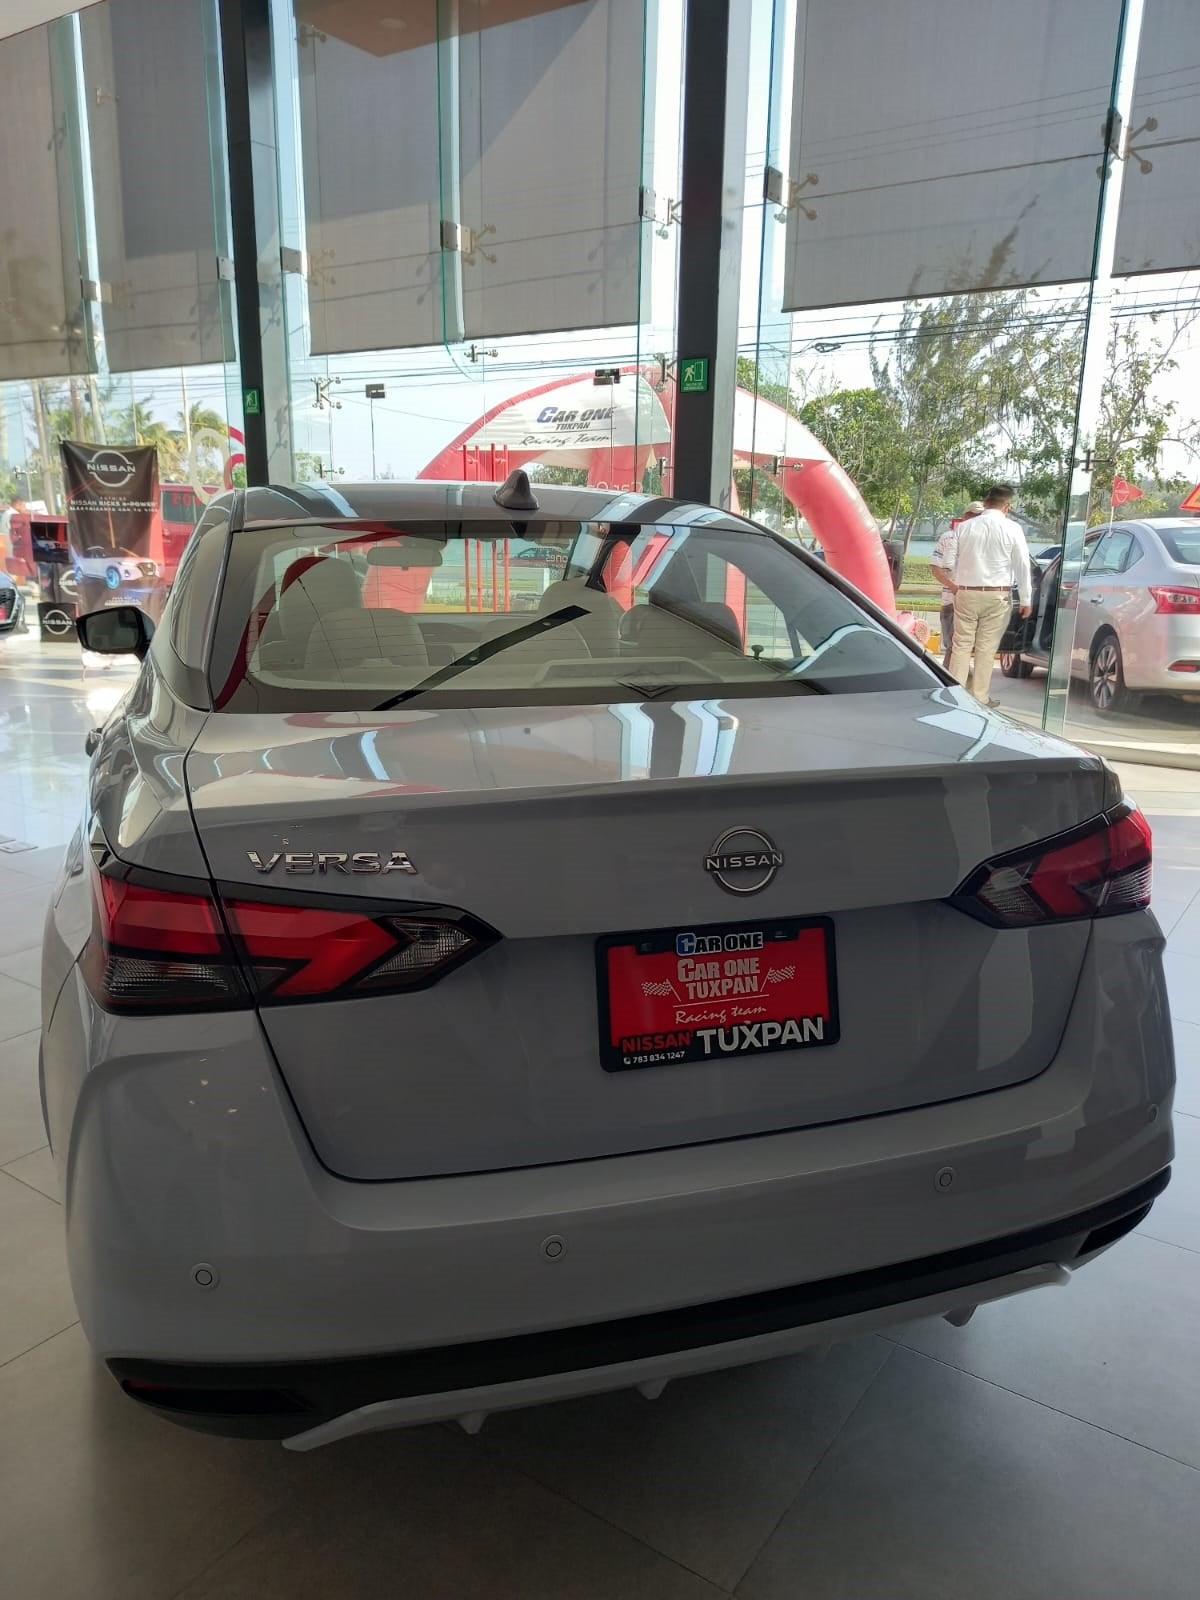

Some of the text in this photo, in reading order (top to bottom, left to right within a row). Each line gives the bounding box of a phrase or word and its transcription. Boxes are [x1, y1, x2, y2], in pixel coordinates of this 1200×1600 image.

[86, 463, 136, 473] NISSAN
[247, 851, 417, 874] VERSA
[706, 854, 783, 869] NISSAN
[677, 932, 763, 956] CAR ONE
[677, 957, 760, 982] CAR ONE
[686, 976, 759, 1000] TUXPAN
[675, 1006, 767, 1025] Racing team
[622, 1017, 824, 1054] NISSAN TUXPAN
[667, 1051, 685, 1059] 1247
